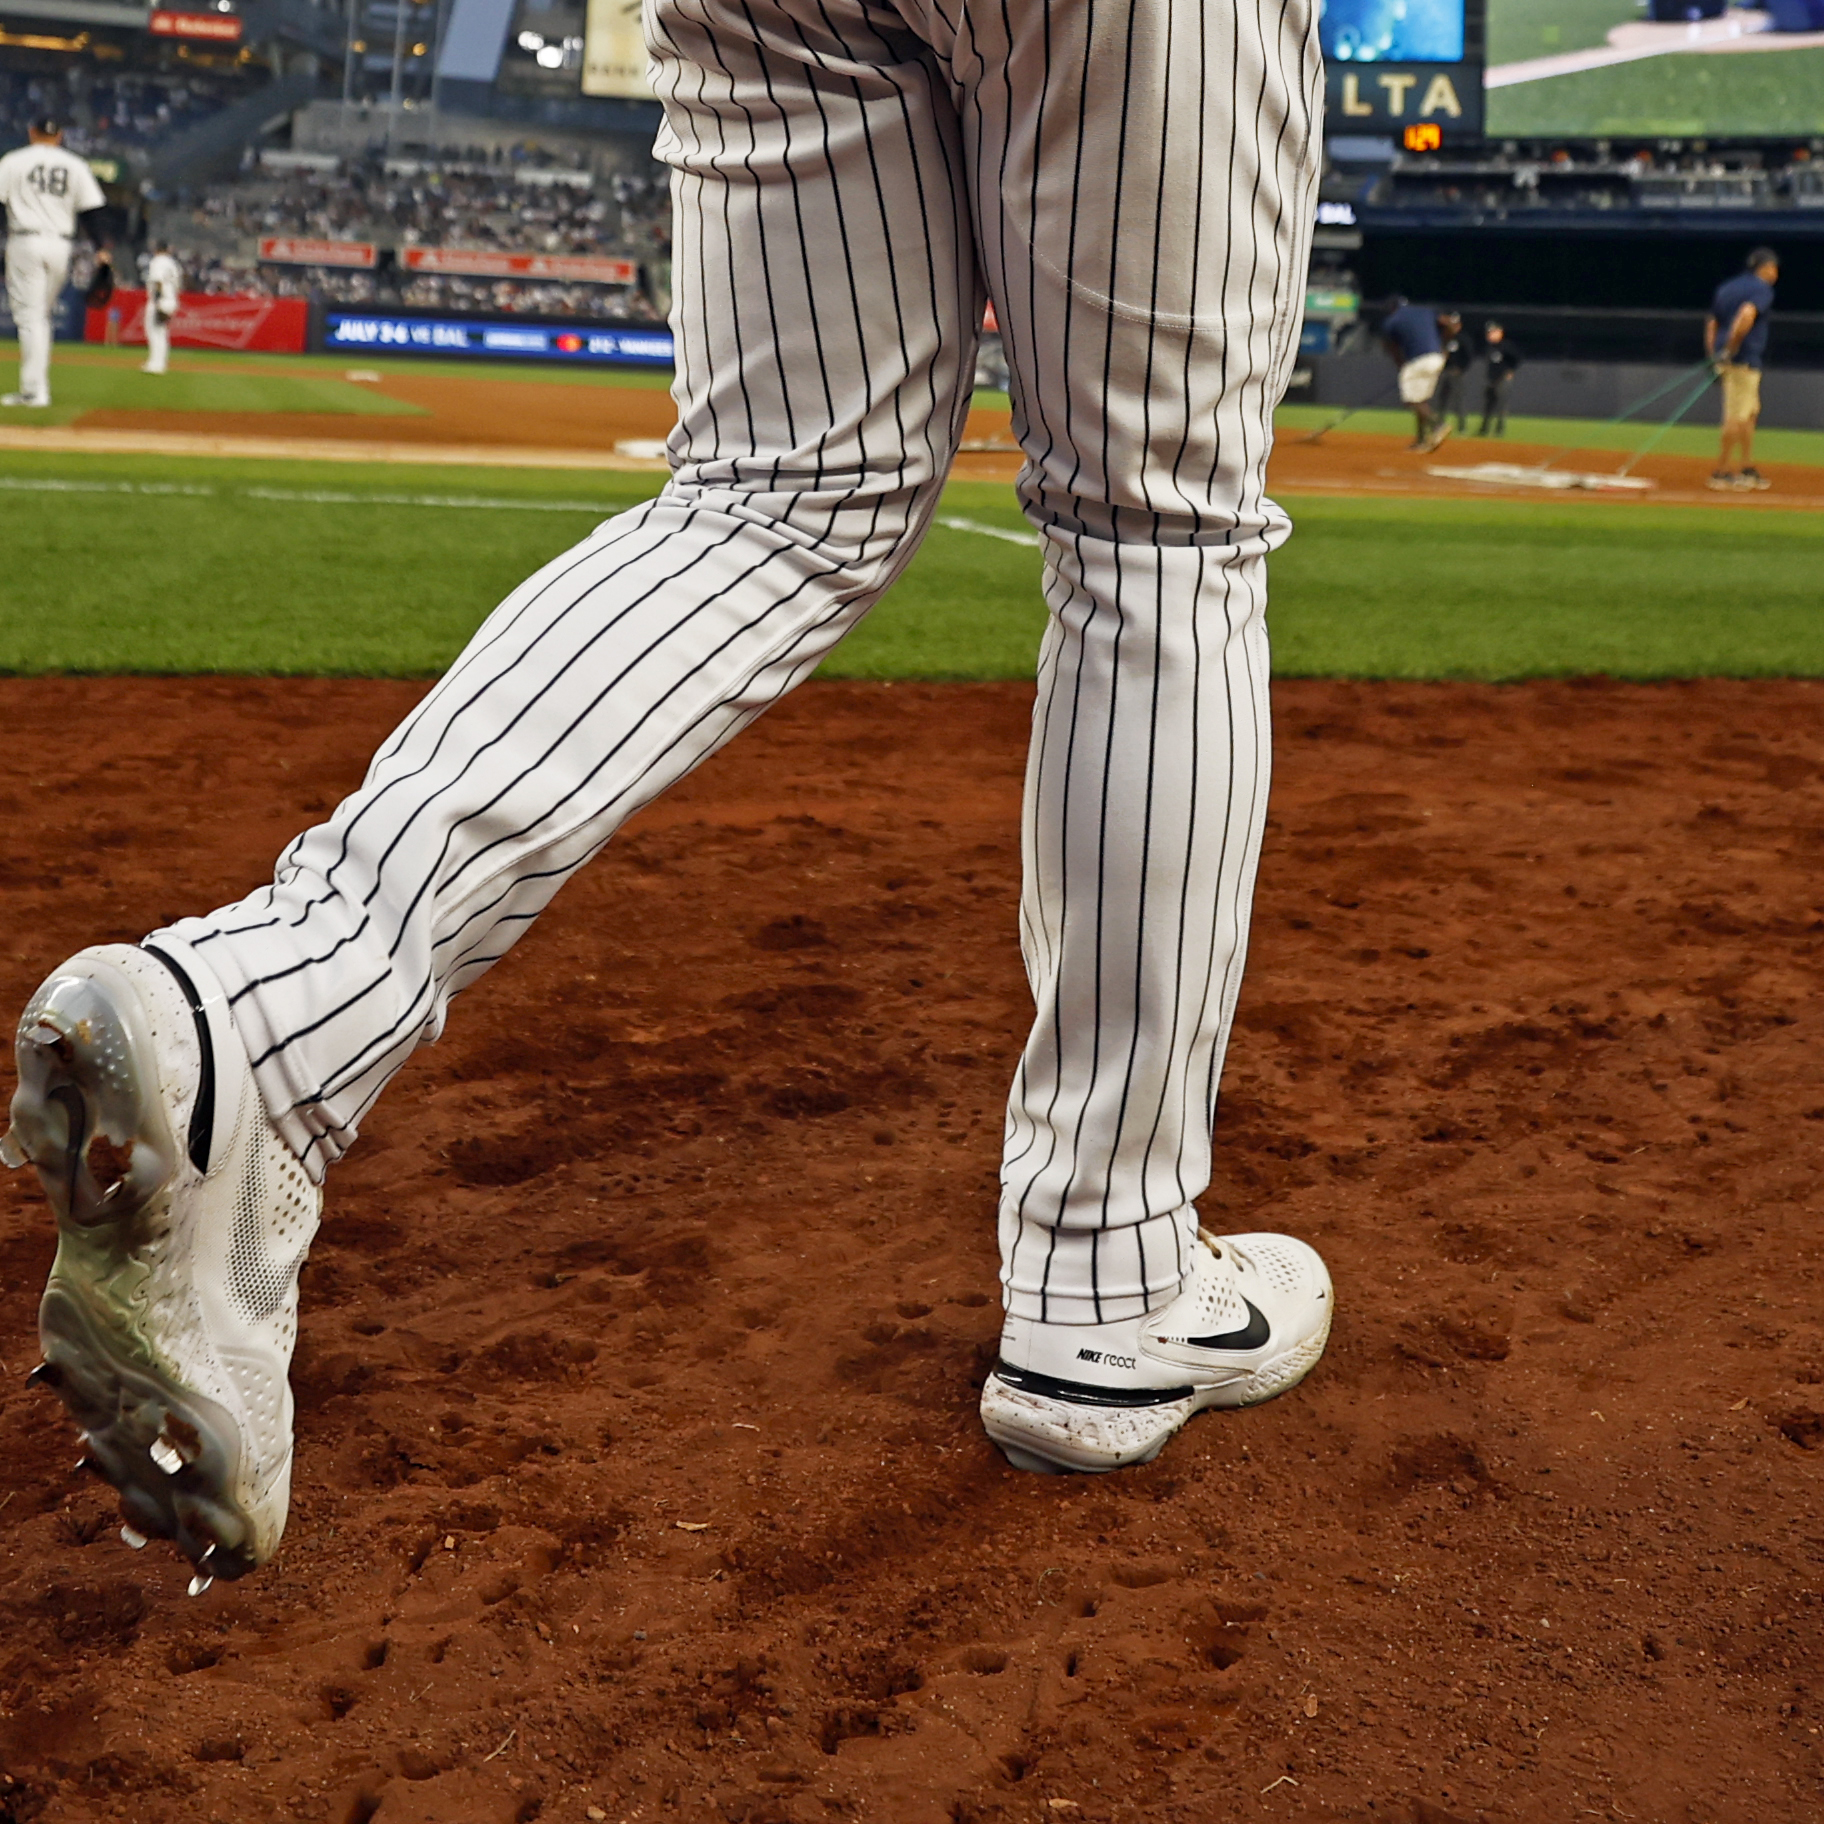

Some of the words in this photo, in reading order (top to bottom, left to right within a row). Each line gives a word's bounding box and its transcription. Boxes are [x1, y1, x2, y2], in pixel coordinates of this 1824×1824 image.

[1325, 72, 1462, 118] LTA
[27, 164, 69, 198] 48
[334, 319, 378, 343] JULY
[432, 323, 470, 348] BAL
[1076, 1347, 1103, 1364] NIKE
[1103, 1350, 1137, 1371] react
